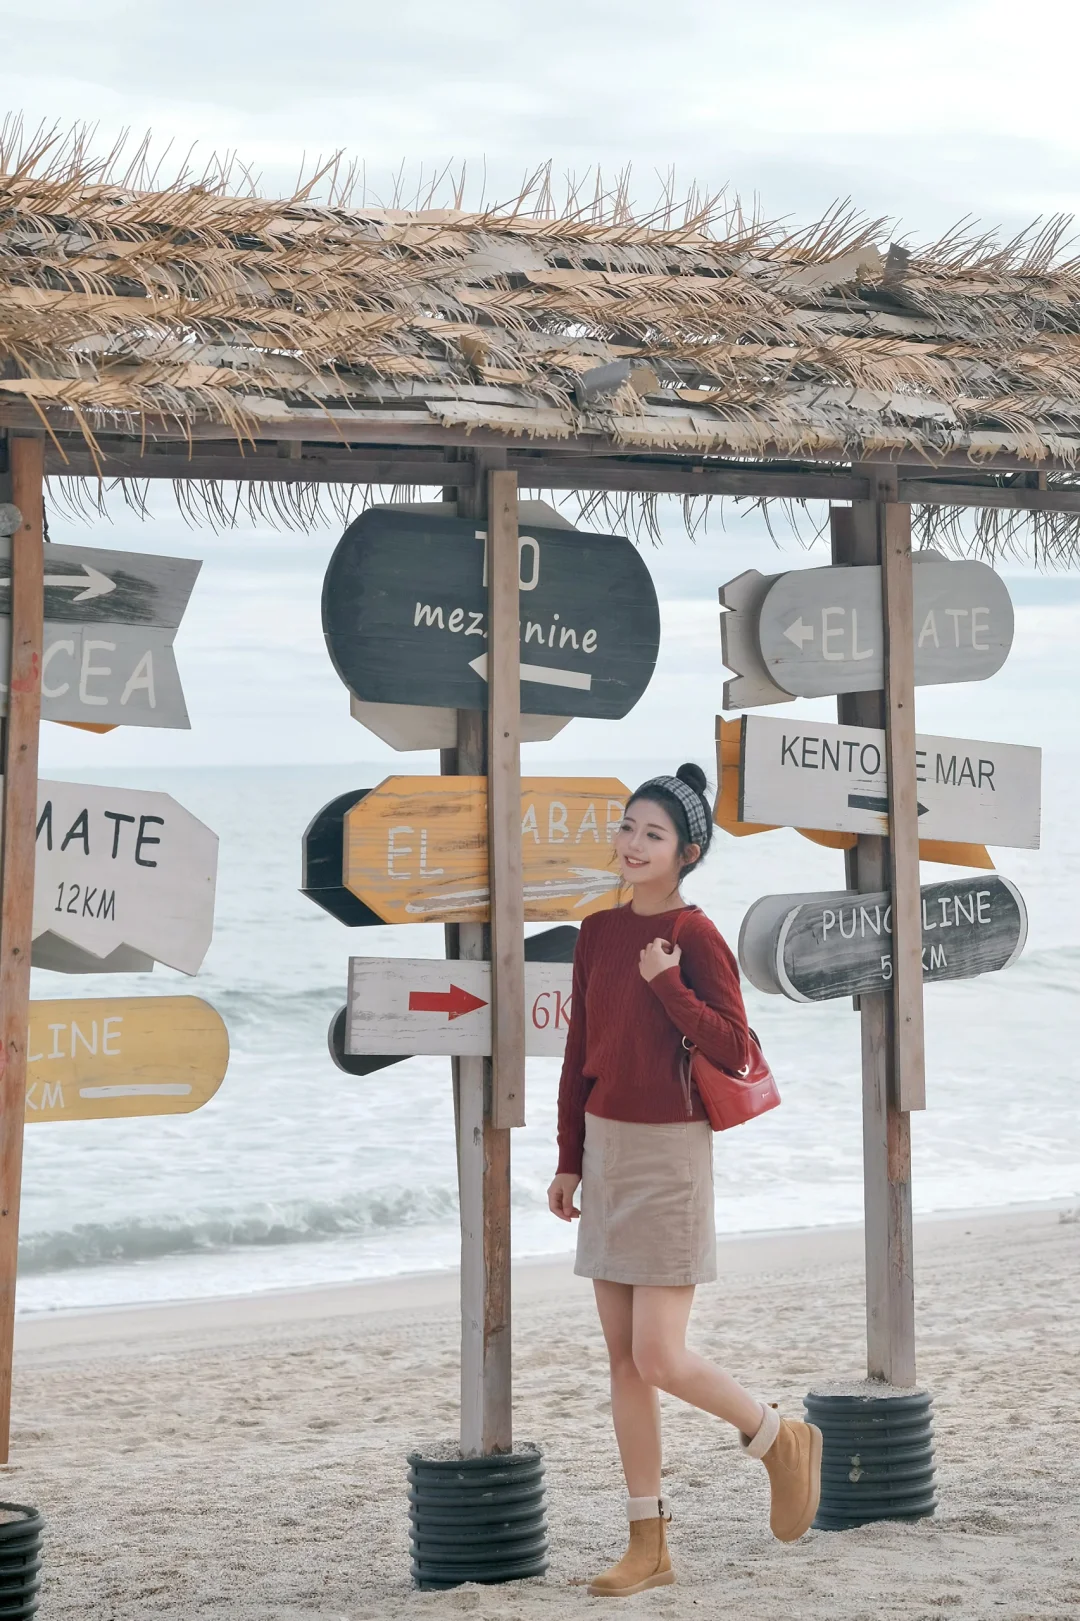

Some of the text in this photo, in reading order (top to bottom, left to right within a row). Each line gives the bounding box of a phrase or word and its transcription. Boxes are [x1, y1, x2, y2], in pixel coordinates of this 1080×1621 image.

[413, 602, 598, 653] meznine
[821, 606, 990, 661] EL ATE
[41, 639, 157, 709] CEA
[781, 735, 881, 775] KENTO
[936, 753, 996, 791] MAR
[387, 800, 625, 880] EL ABAR
[54, 881, 116, 922] 12KM
[531, 990, 573, 1030] 6K
